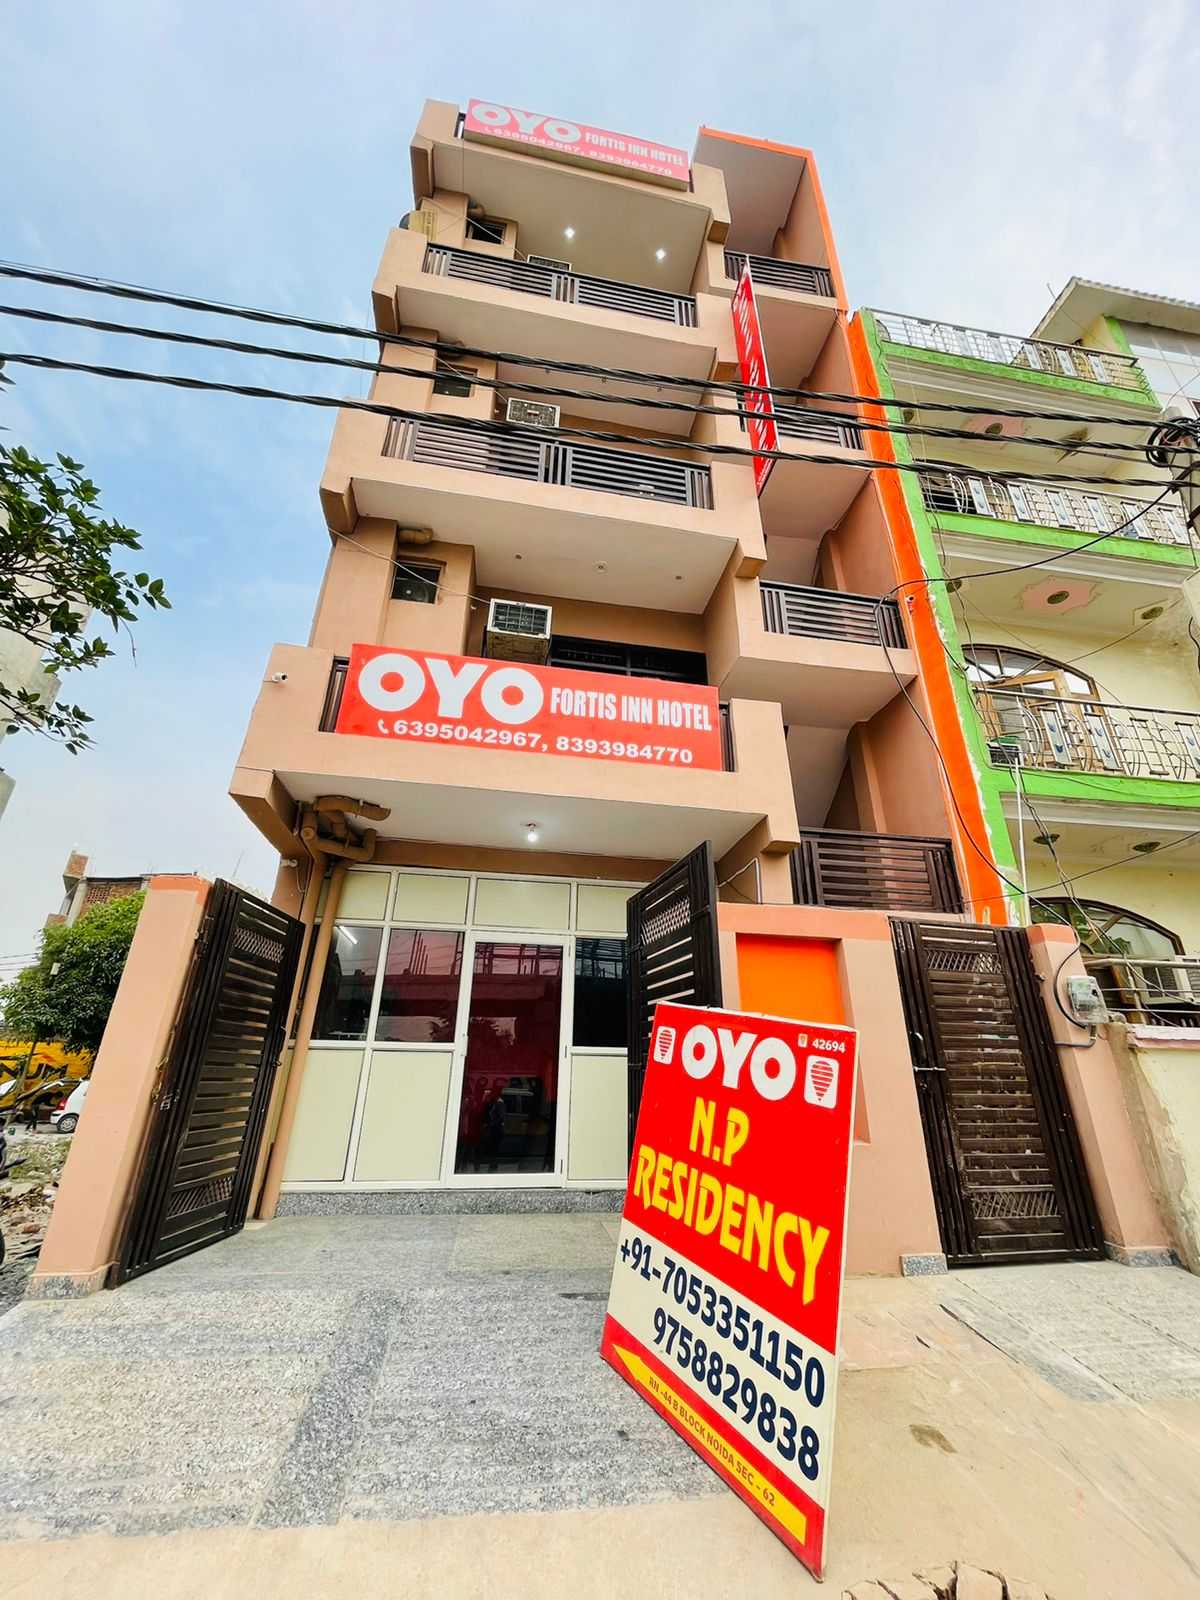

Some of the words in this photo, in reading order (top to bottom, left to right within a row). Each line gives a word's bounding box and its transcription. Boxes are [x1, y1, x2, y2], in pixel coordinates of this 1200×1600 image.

[472, 102, 580, 143] OYO
[358, 653, 544, 725] OYO
[550, 687, 617, 721] FORTIS
[621, 695, 652, 724] INN
[657, 701, 713, 731] HOTEL
[393, 719, 548, 752] 6395042967,
[556, 735, 693, 764] 8393984770
[681, 1024, 797, 1101] OYO
[811, 1038, 846, 1054] 42694
[689, 1096, 750, 1167] N.P
[633, 1144, 831, 1306] RESIDENCY
[620, 1237, 825, 1408] +91-7053351150
[653, 1307, 820, 1481] 9758829838
[679, 1407, 707, 1439] BLOCK
[706, 1431, 735, 1469] NOIDA
[735, 1460, 755, 1487] SEC
[762, 1487, 776, 1507] 62
